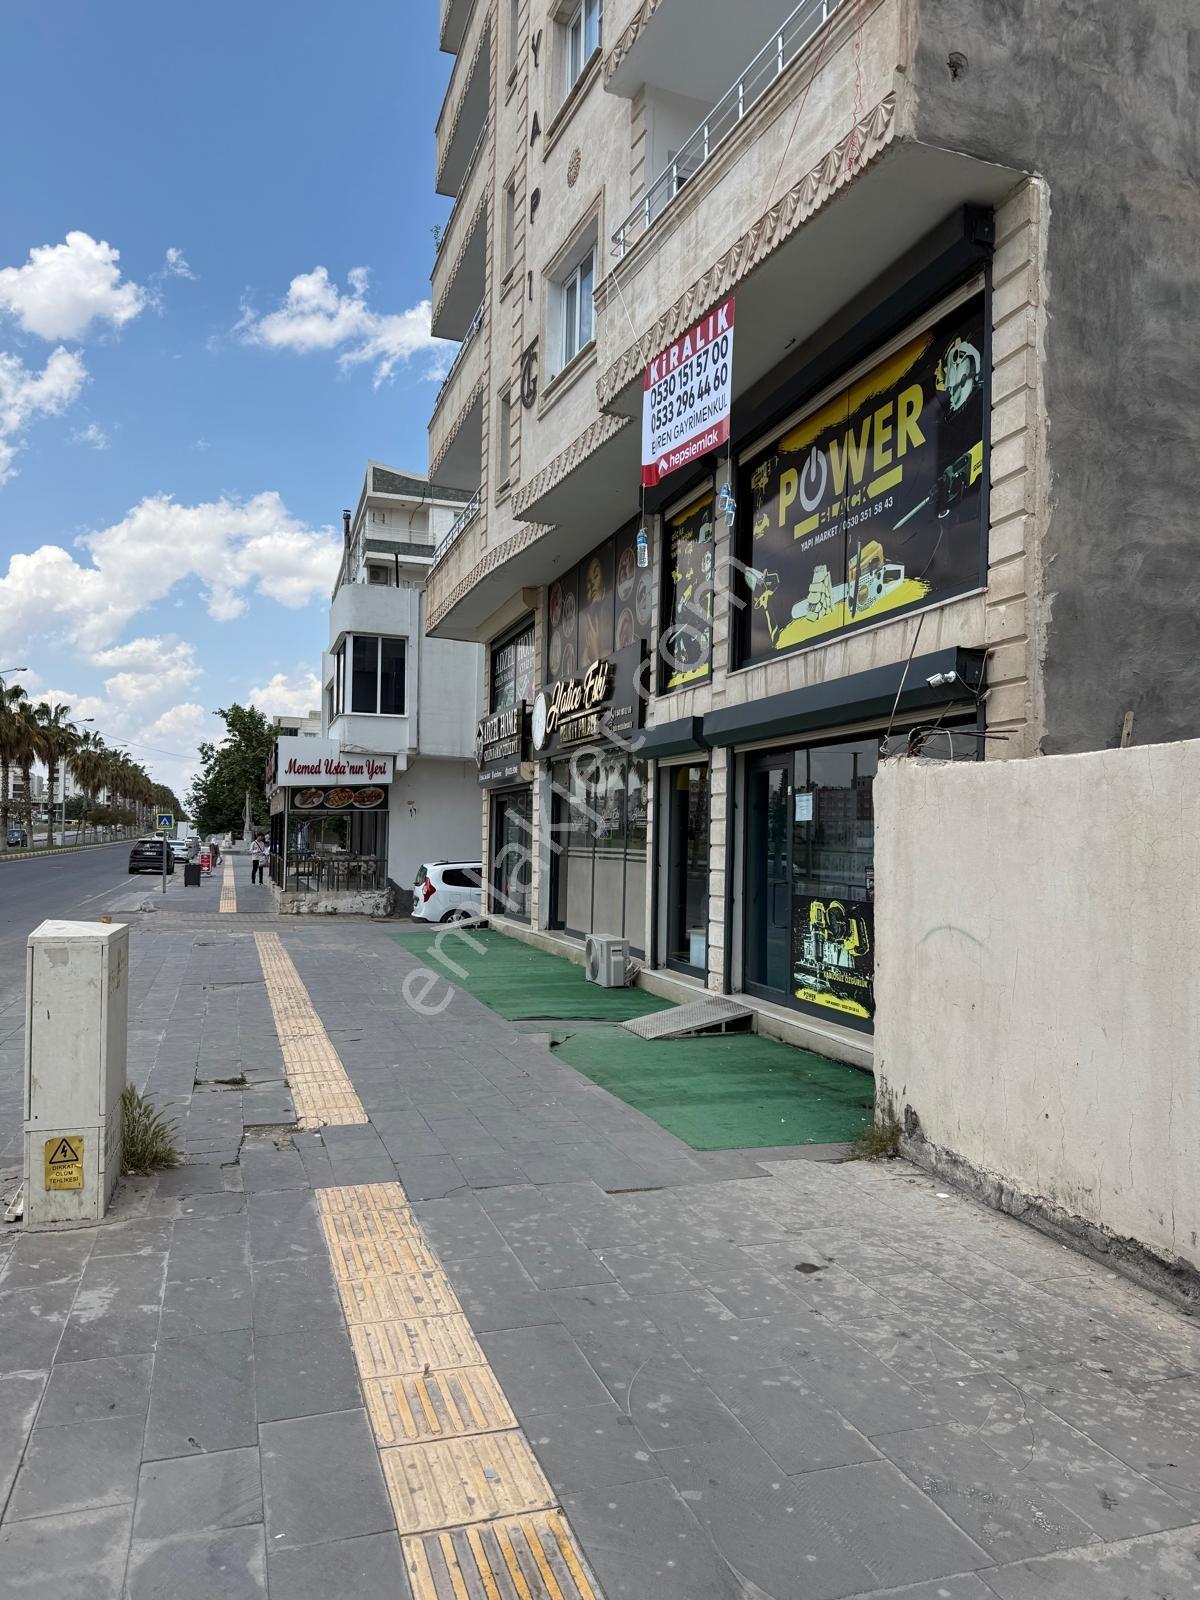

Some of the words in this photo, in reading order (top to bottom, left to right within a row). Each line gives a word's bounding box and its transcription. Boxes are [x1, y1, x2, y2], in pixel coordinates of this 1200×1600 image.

[650, 303, 729, 386] KİRALIK
[651, 373, 676, 408] 0530
[677, 360, 694, 390] 151
[696, 348, 709, 378] 57
[712, 334, 728, 366] 00
[651, 400, 674, 434] 0533
[676, 386, 695, 418] 296
[697, 374, 711, 401] 44
[713, 362, 728, 391] 60
[669, 428, 719, 468] hepsiemlak
[779, 383, 926, 527] POWER
[800, 539, 814, 553] YAPI
[814, 525, 839, 546] MARKET
[860, 507, 872, 522] 351
[873, 501, 883, 515] 58
[884, 496, 894, 509] 43
[285, 757, 322, 775] Memed
[365, 759, 387, 780] Yeri
